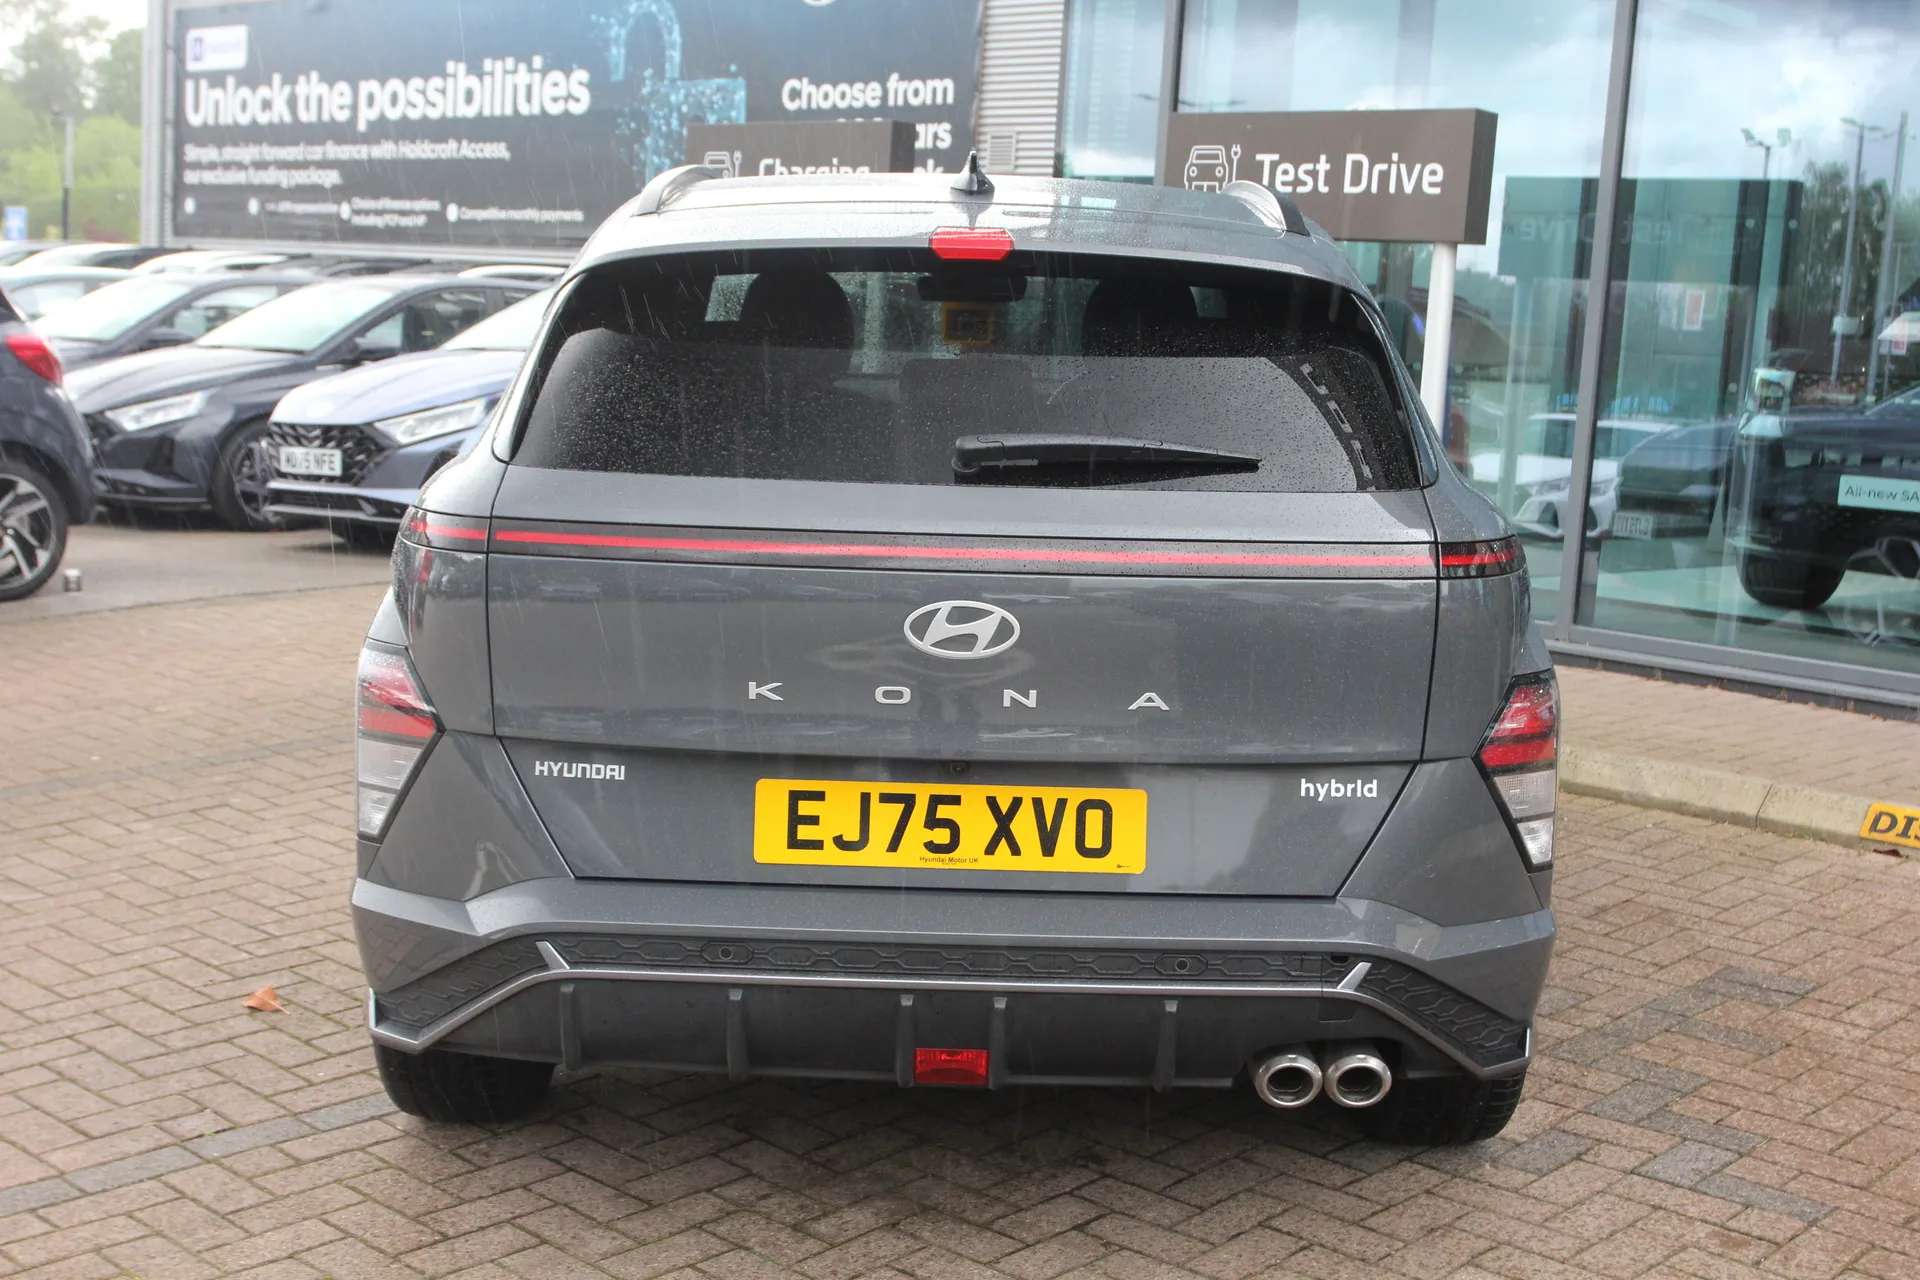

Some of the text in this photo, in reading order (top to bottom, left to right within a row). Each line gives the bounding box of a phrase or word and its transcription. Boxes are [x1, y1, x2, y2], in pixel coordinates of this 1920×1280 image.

[184, 55, 592, 133] Unlock the possibilities
[782, 72, 956, 111] Choose from
[914, 121, 952, 150] ars
[1255, 152, 1444, 195] Test Drive
[747, 681, 1171, 712] KONA
[534, 760, 626, 780] HYUNDAI
[1300, 778, 1378, 801] hybrid
[787, 789, 1113, 859] EJ75 XVO
[1868, 811, 1920, 841] DI
[919, 855, 947, 864] Hyundai
[948, 856, 967, 864] Motor
